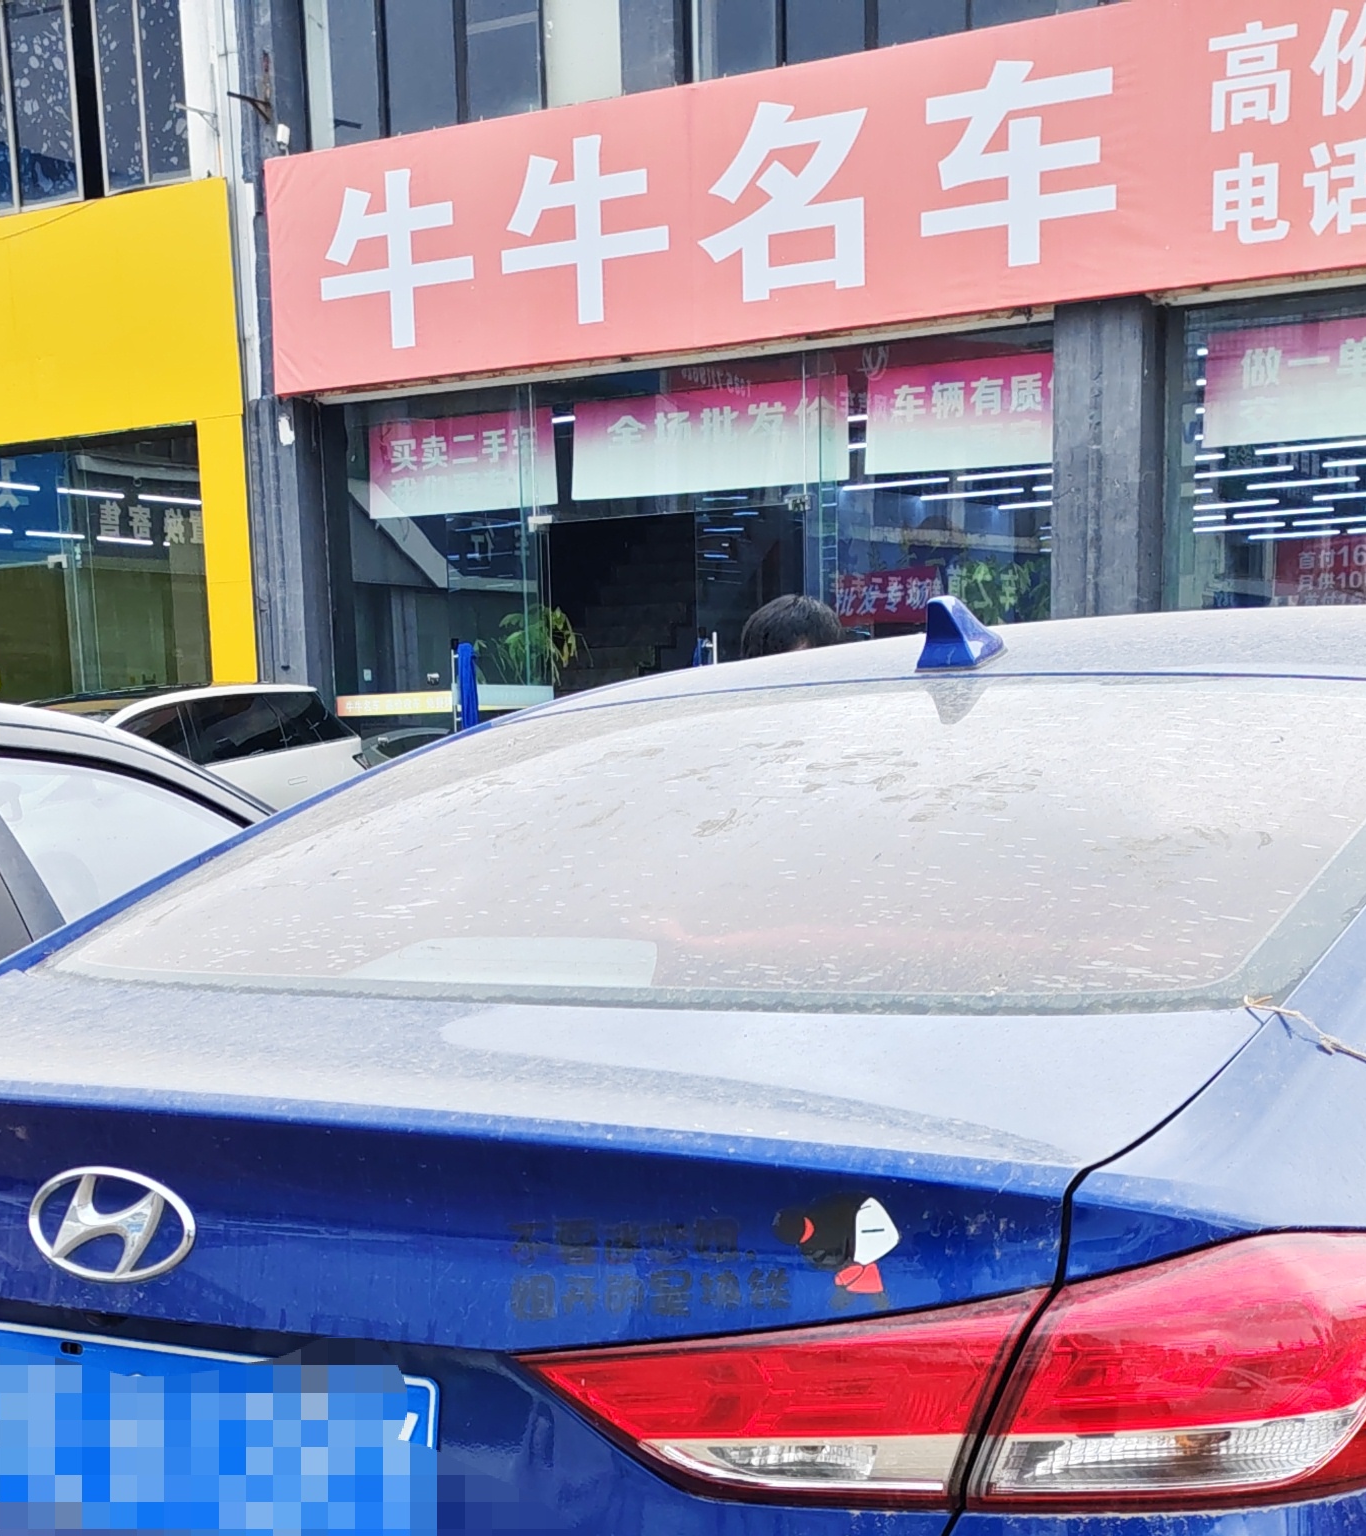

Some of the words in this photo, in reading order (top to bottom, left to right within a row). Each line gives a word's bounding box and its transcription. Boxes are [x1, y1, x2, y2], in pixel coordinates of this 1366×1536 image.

[321, 60, 1117, 348] 牛牛名车
[893, 372, 1054, 422] 车辆有质
